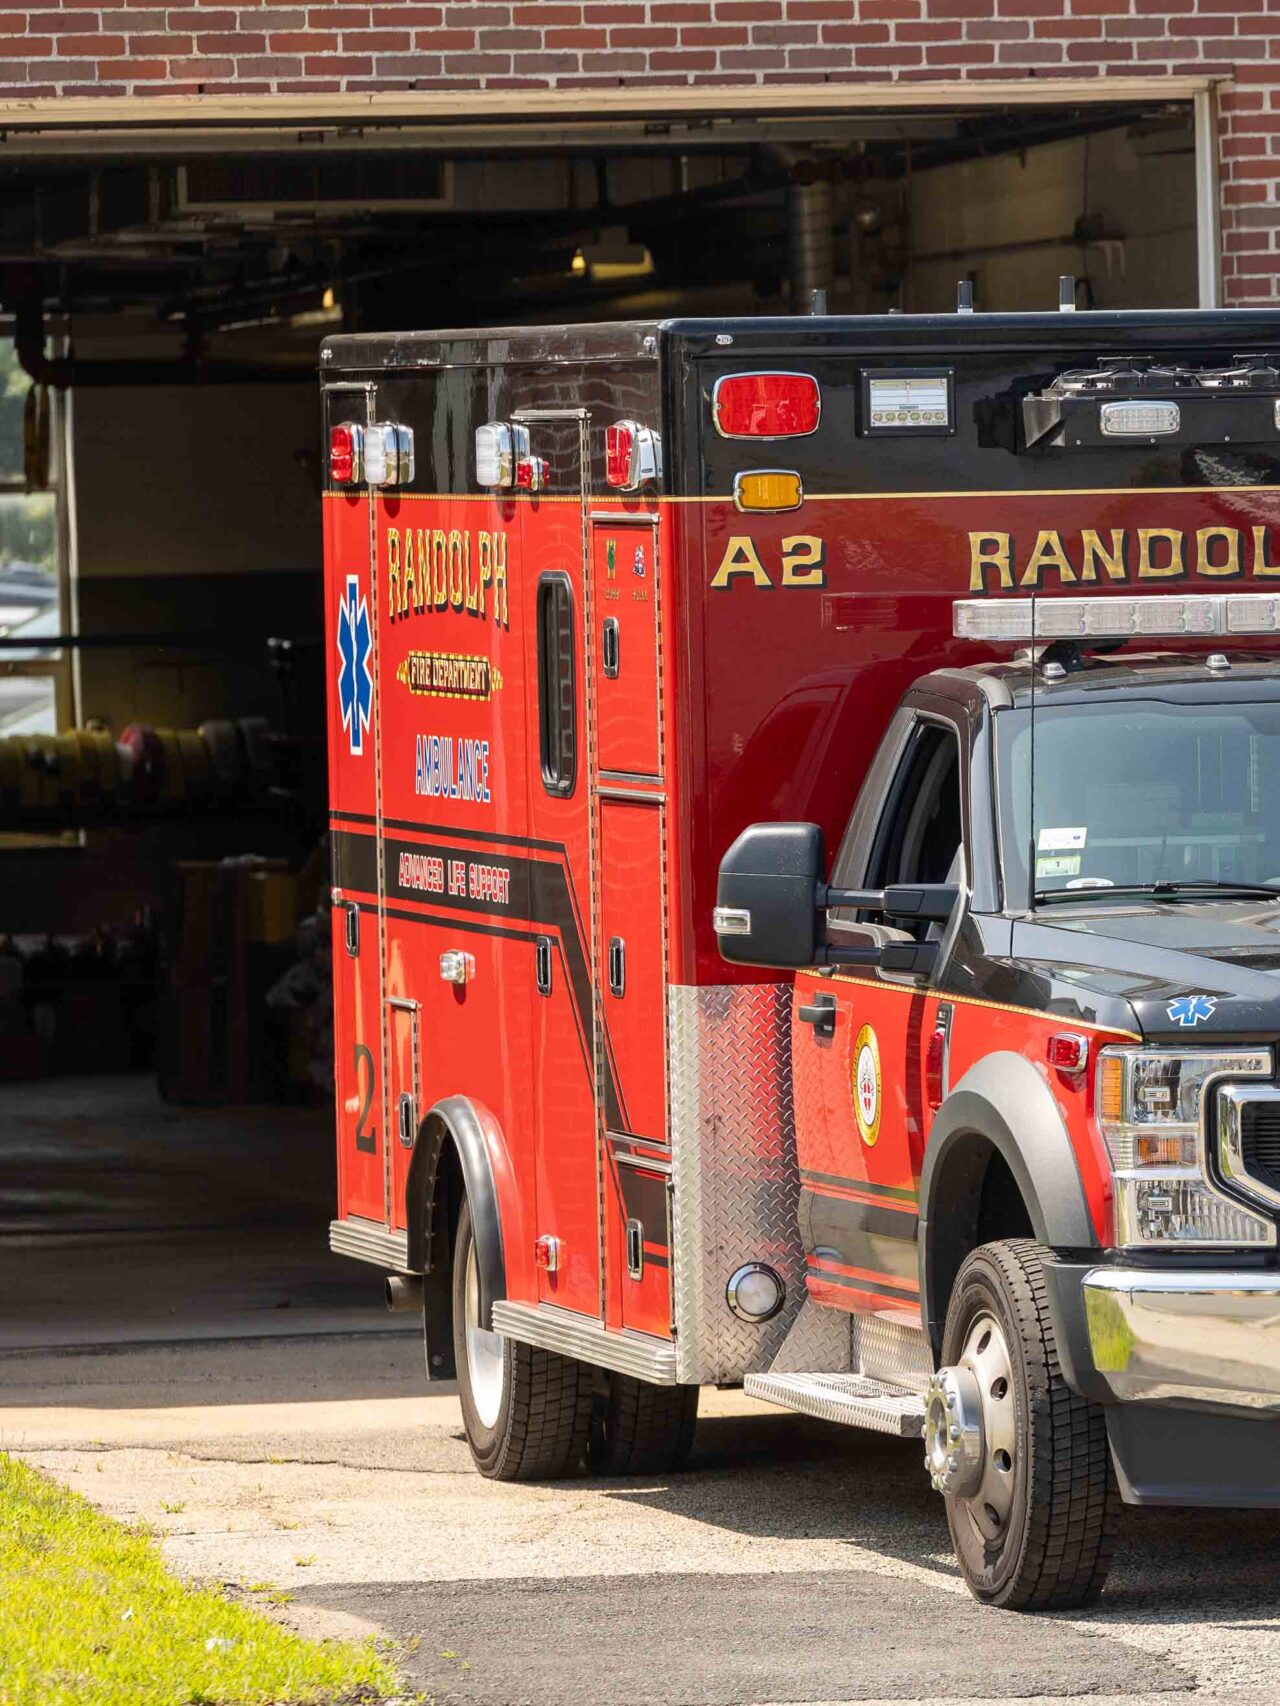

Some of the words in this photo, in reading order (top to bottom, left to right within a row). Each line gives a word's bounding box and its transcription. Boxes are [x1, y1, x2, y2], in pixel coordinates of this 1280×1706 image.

[387, 527, 509, 631] RANDOLPH
[710, 535, 826, 590] A2
[411, 656, 432, 686] FIRE
[432, 658, 487, 690] DEPARTMENT
[415, 734, 491, 803] AMBULANCE
[398, 852, 444, 893] ADVANCED
[447, 859, 466, 897] LIFE
[468, 863, 510, 905] SUPPORT
[353, 1043, 376, 1156] 2
